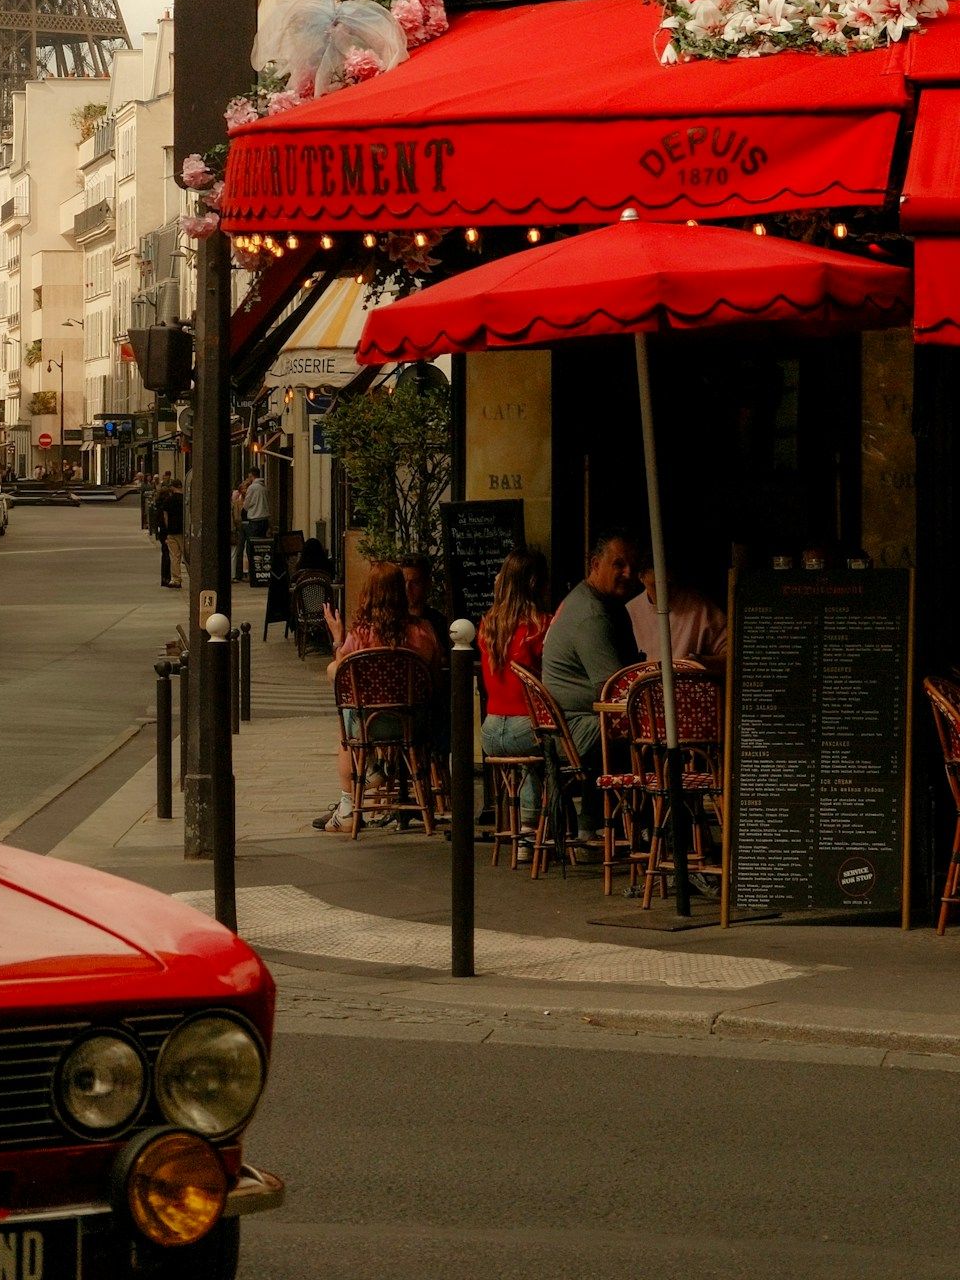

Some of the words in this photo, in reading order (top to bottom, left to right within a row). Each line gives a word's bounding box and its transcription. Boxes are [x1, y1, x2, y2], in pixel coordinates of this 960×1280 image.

[639, 127, 768, 177] DEPUIS
[243, 138, 455, 198] RECRUTEMENT
[679, 167, 729, 186] 1870
[488, 474, 523, 490] BAR
[841, 877, 855, 885] NON
[856, 873, 873, 883] STOP
[843, 866, 869, 878] SERVICE
